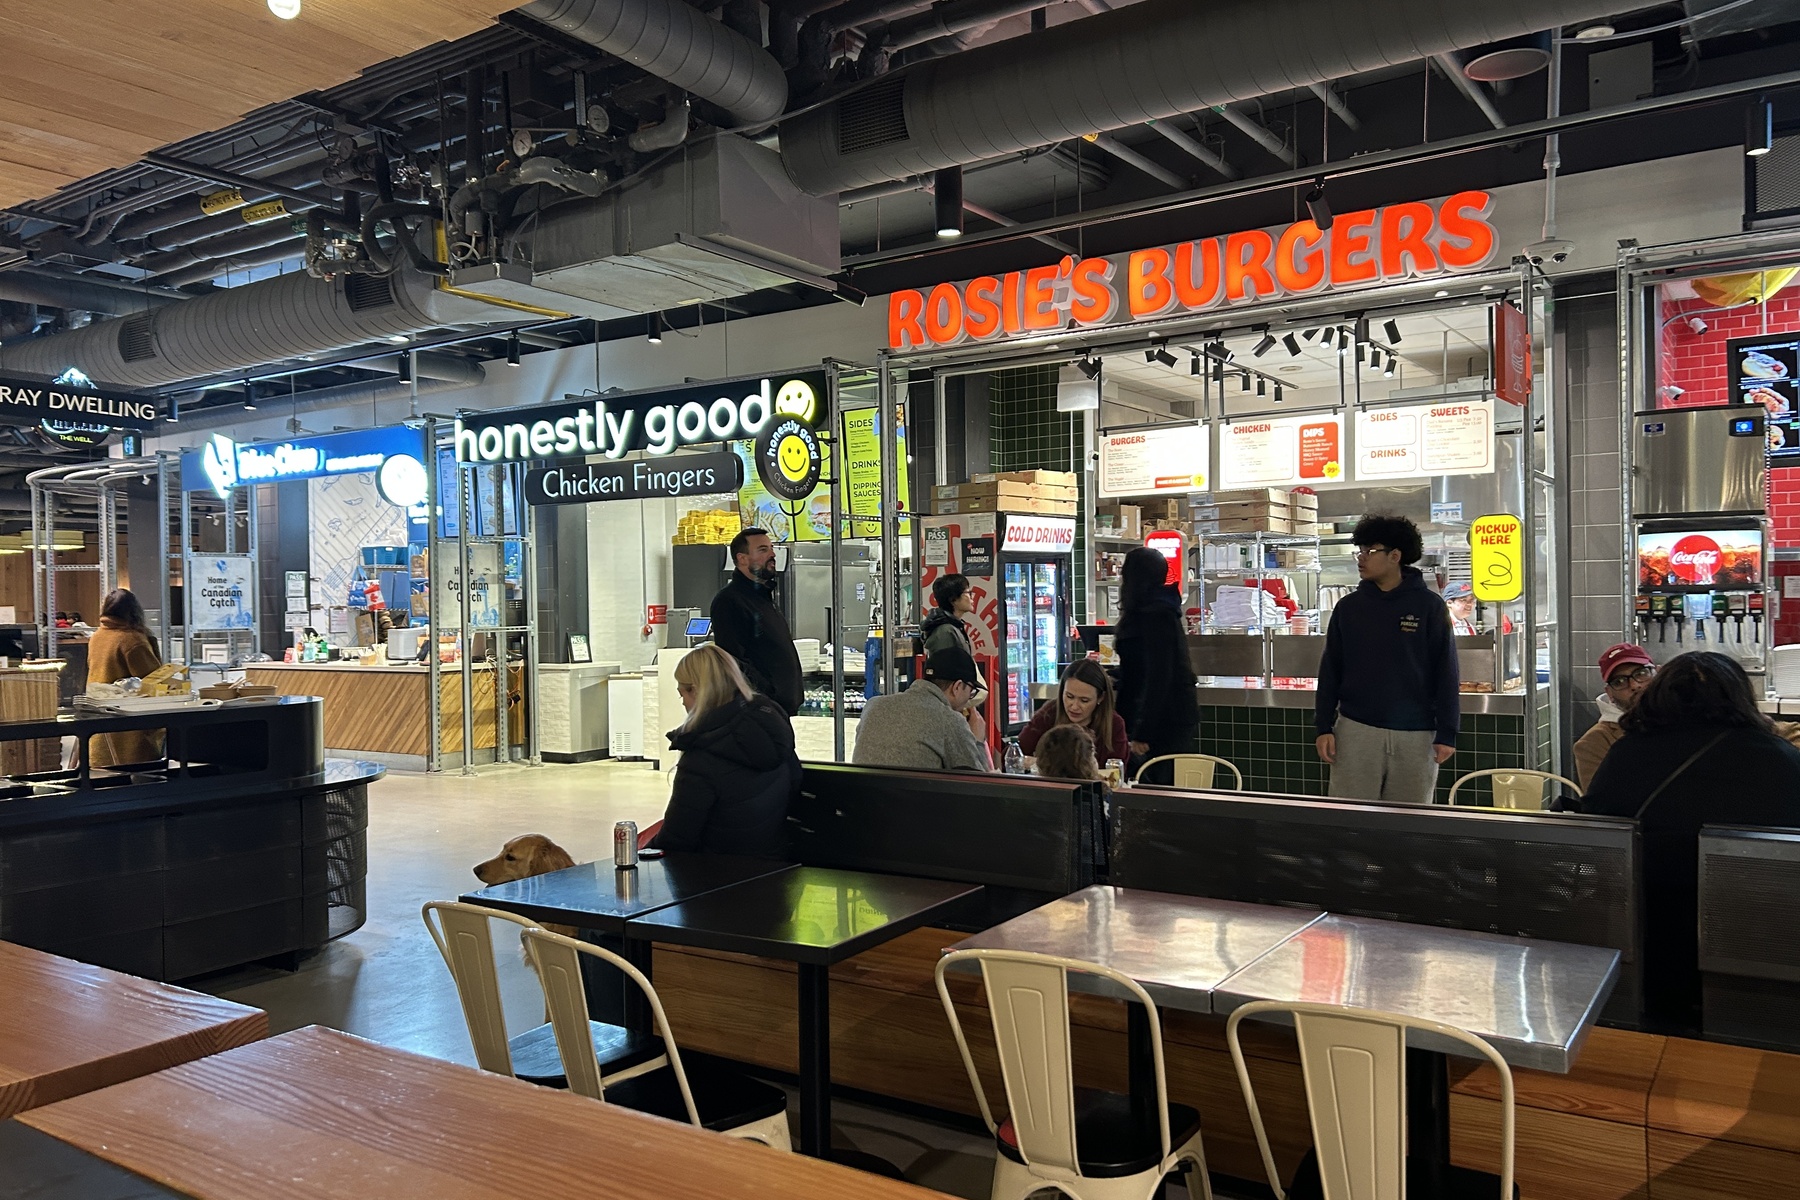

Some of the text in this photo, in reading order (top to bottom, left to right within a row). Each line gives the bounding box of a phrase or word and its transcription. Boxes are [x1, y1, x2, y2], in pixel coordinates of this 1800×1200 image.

[889, 190, 1495, 348] ROSIE'S BURGERS
[49, 392, 156, 420] DWELLING
[1430, 406, 1470, 417] SWEETS
[455, 378, 771, 459] honestly good
[1370, 412, 1398, 422] SIDES
[848, 418, 873, 429] SIDES
[1233, 424, 1271, 434] CHICKEN
[1303, 427, 1325, 438] DIPS
[766, 420, 800, 457] honestly
[799, 428, 819, 460] good
[1110, 435, 1146, 446] BURGERS
[1370, 448, 1407, 458] DRINKS
[542, 470, 624, 498] Chicken
[633, 463, 715, 495] Fingers
[773, 472, 794, 494] Chicken
[794, 476, 813, 494] Fingers
[1475, 523, 1517, 534] PICKUP
[927, 531, 947, 540] PASS
[1007, 525, 1034, 543] COLD
[1034, 527, 1073, 544] DRINKS
[1480, 535, 1511, 545] HERE
[970, 547, 985, 555] NOW
[454, 566, 474, 575] He
[207, 576, 227, 584] Home
[447, 579, 489, 591] Cadian
[201, 587, 243, 597] Canadian
[456, 591, 482, 602] Cch
[572, 635, 584, 644] PASS
